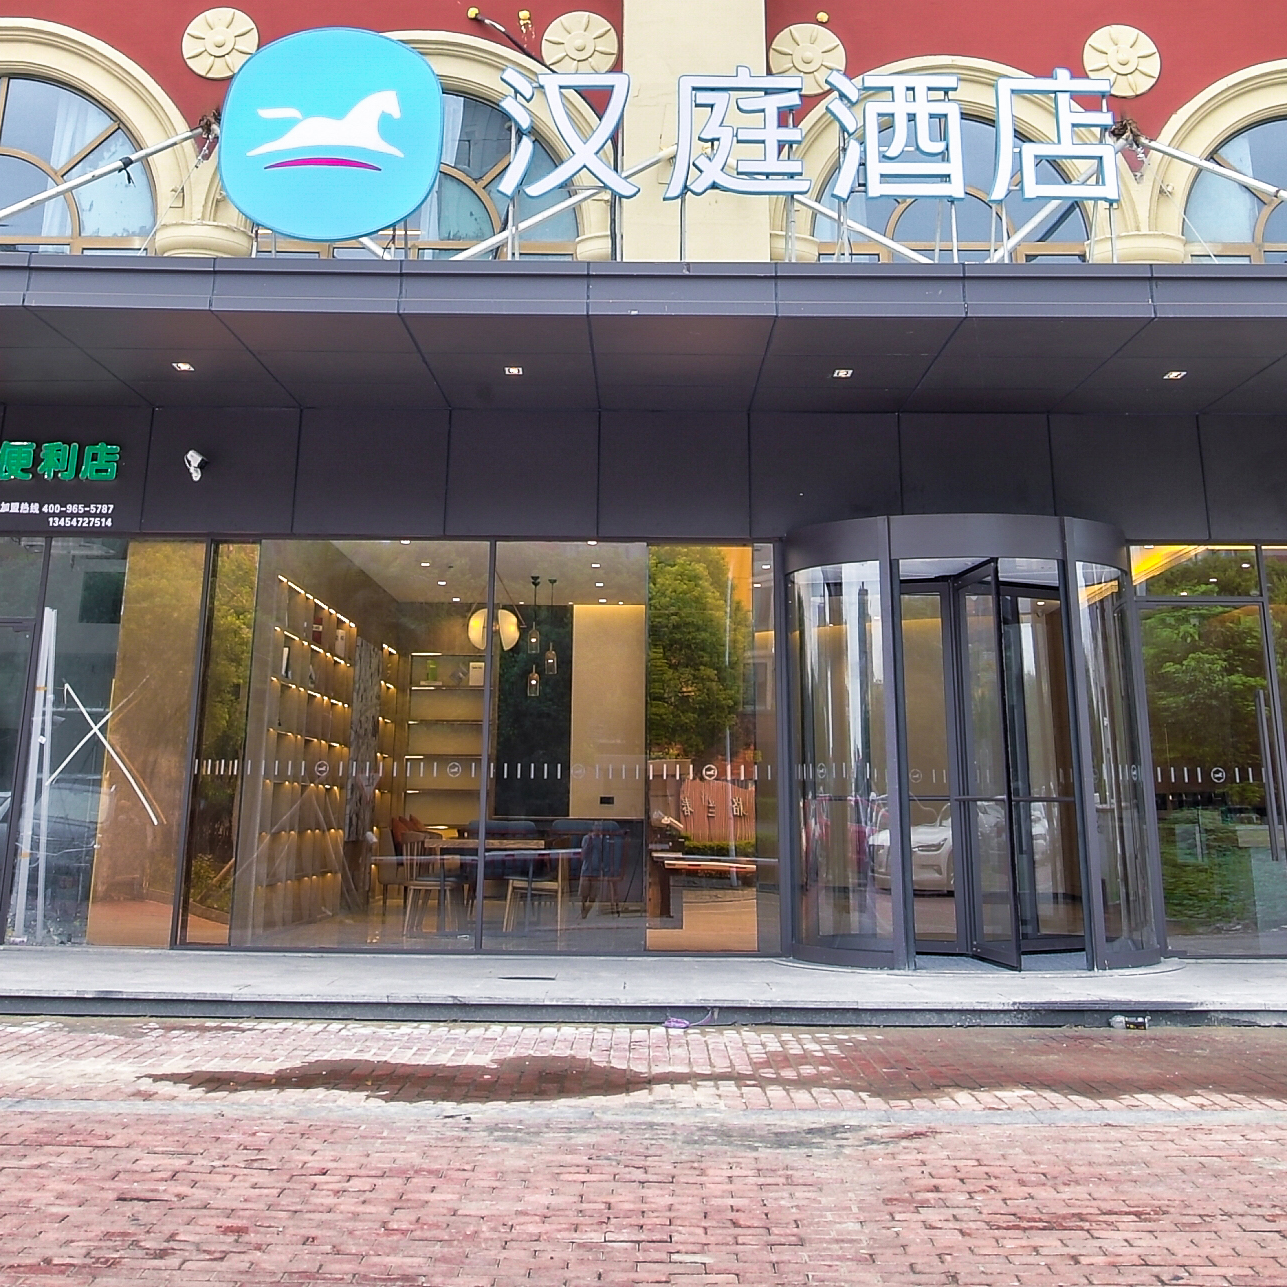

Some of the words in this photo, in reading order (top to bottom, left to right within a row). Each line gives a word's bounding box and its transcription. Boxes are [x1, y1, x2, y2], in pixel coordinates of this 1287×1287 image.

[496, 65, 1121, 203] 汉庭酒店
[0, 502, 40, 514] 加盟热线
[41, 503, 115, 515] 400-965-5787
[48, 517, 112, 527] 13454727514
